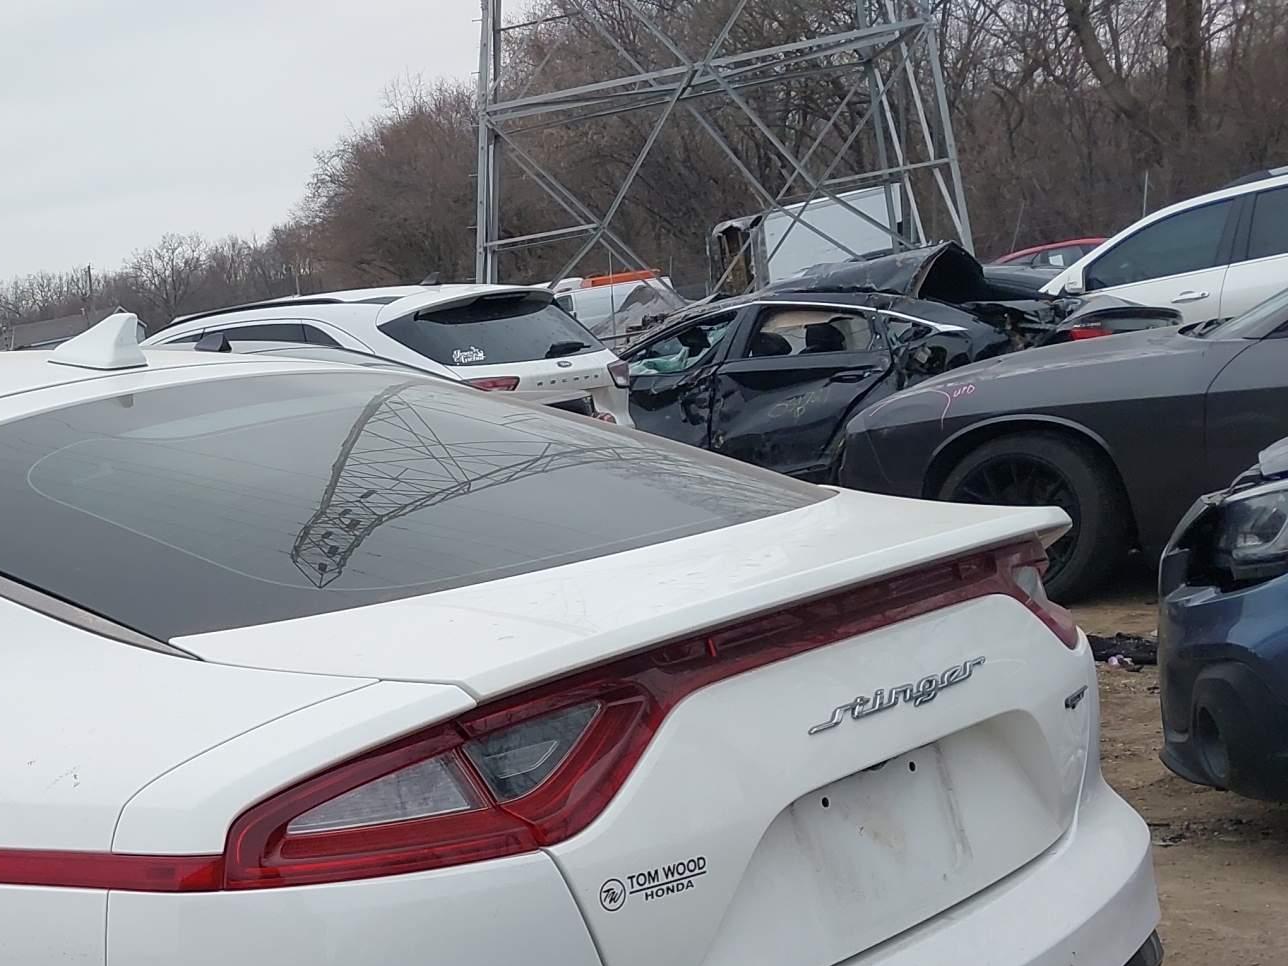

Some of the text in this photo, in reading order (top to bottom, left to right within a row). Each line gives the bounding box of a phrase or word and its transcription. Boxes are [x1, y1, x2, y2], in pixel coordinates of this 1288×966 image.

[627, 856, 707, 889] TOM WOOD
[645, 879, 695, 901] HONDA
